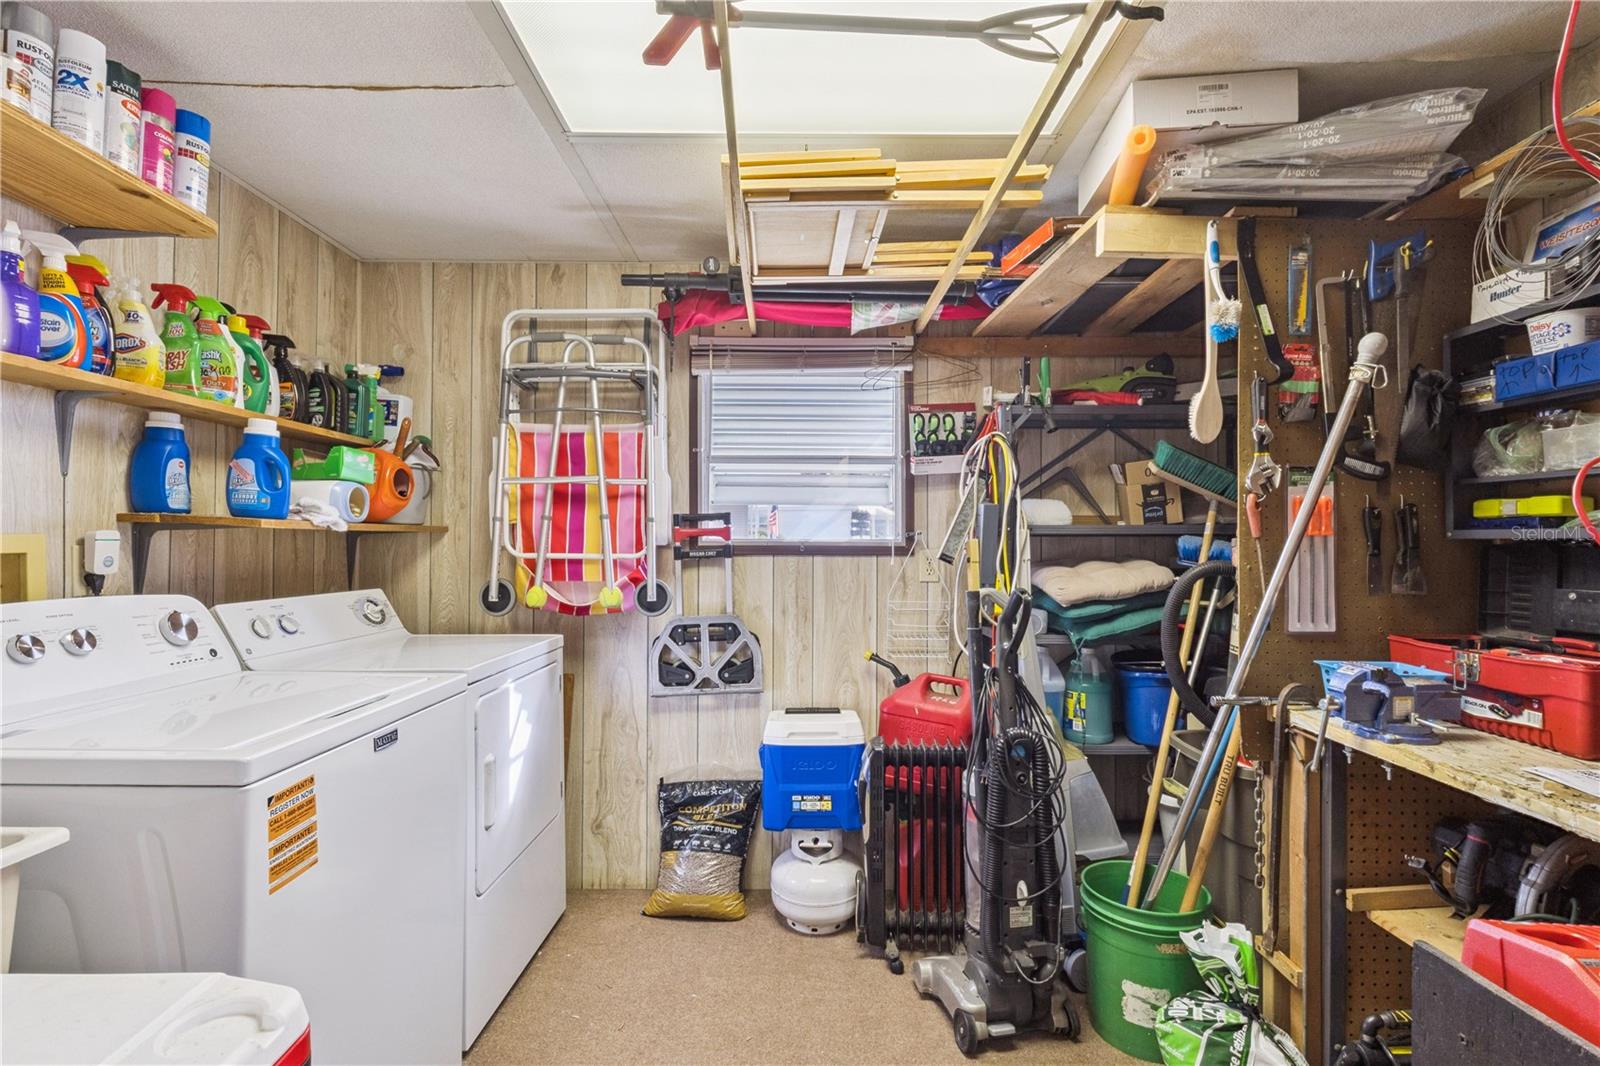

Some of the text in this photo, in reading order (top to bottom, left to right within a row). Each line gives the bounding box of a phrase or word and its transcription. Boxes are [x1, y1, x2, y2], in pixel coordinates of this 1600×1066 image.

[57, 69, 90, 92] 2X
[112, 80, 139, 98] SATIN
[1490, 284, 1522, 302] Hunter
[1214, 755, 1234, 806] TRU BUILT
[270, 795, 300, 817] REGISTER
[301, 788, 314, 799] NOW
[270, 814, 284, 827] CALL
[715, 827, 738, 835] BLEND
